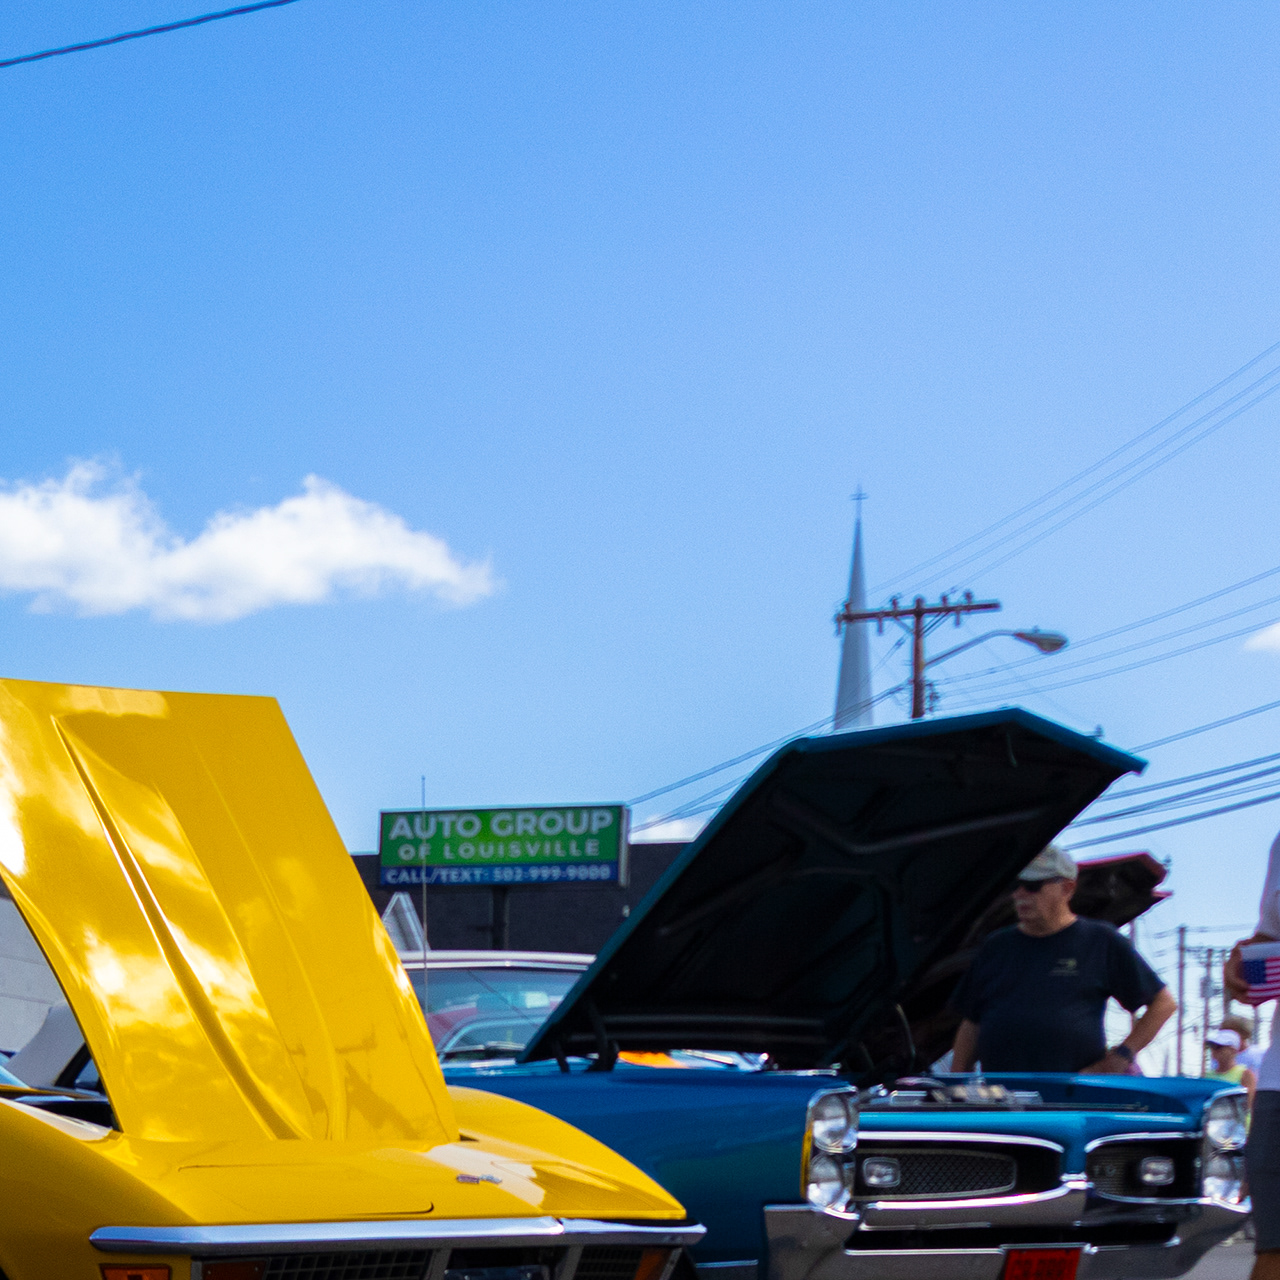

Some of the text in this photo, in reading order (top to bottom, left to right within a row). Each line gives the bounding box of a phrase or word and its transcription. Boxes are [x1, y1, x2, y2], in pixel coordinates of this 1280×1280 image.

[389, 810, 614, 840] AUTO GROUP
[398, 838, 601, 861] OF LOUISVILLE
[385, 866, 490, 885] CALL/TEXT:
